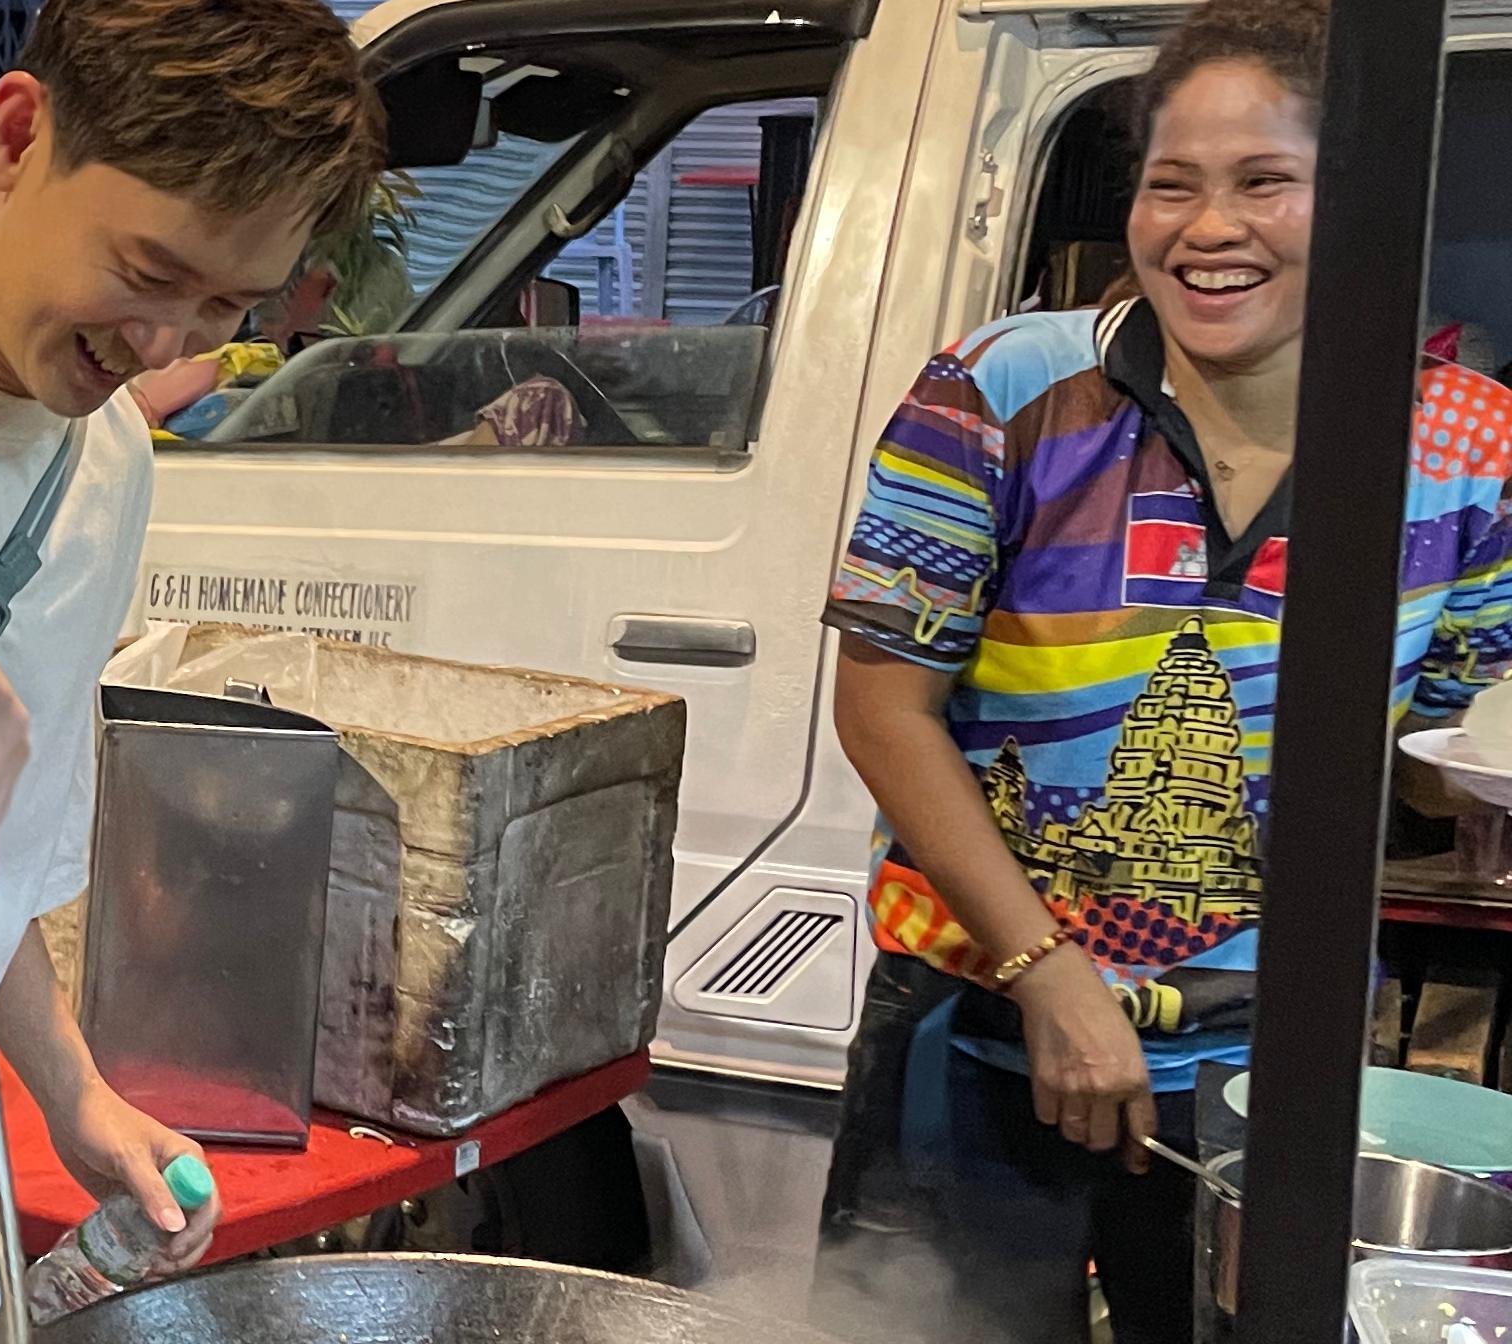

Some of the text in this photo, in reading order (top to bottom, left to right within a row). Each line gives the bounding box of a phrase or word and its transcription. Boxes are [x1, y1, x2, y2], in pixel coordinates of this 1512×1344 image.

[179, 574, 191, 609] H
[197, 575, 287, 616] HOMEMADE
[294, 580, 417, 622] CONFECTIONERY
